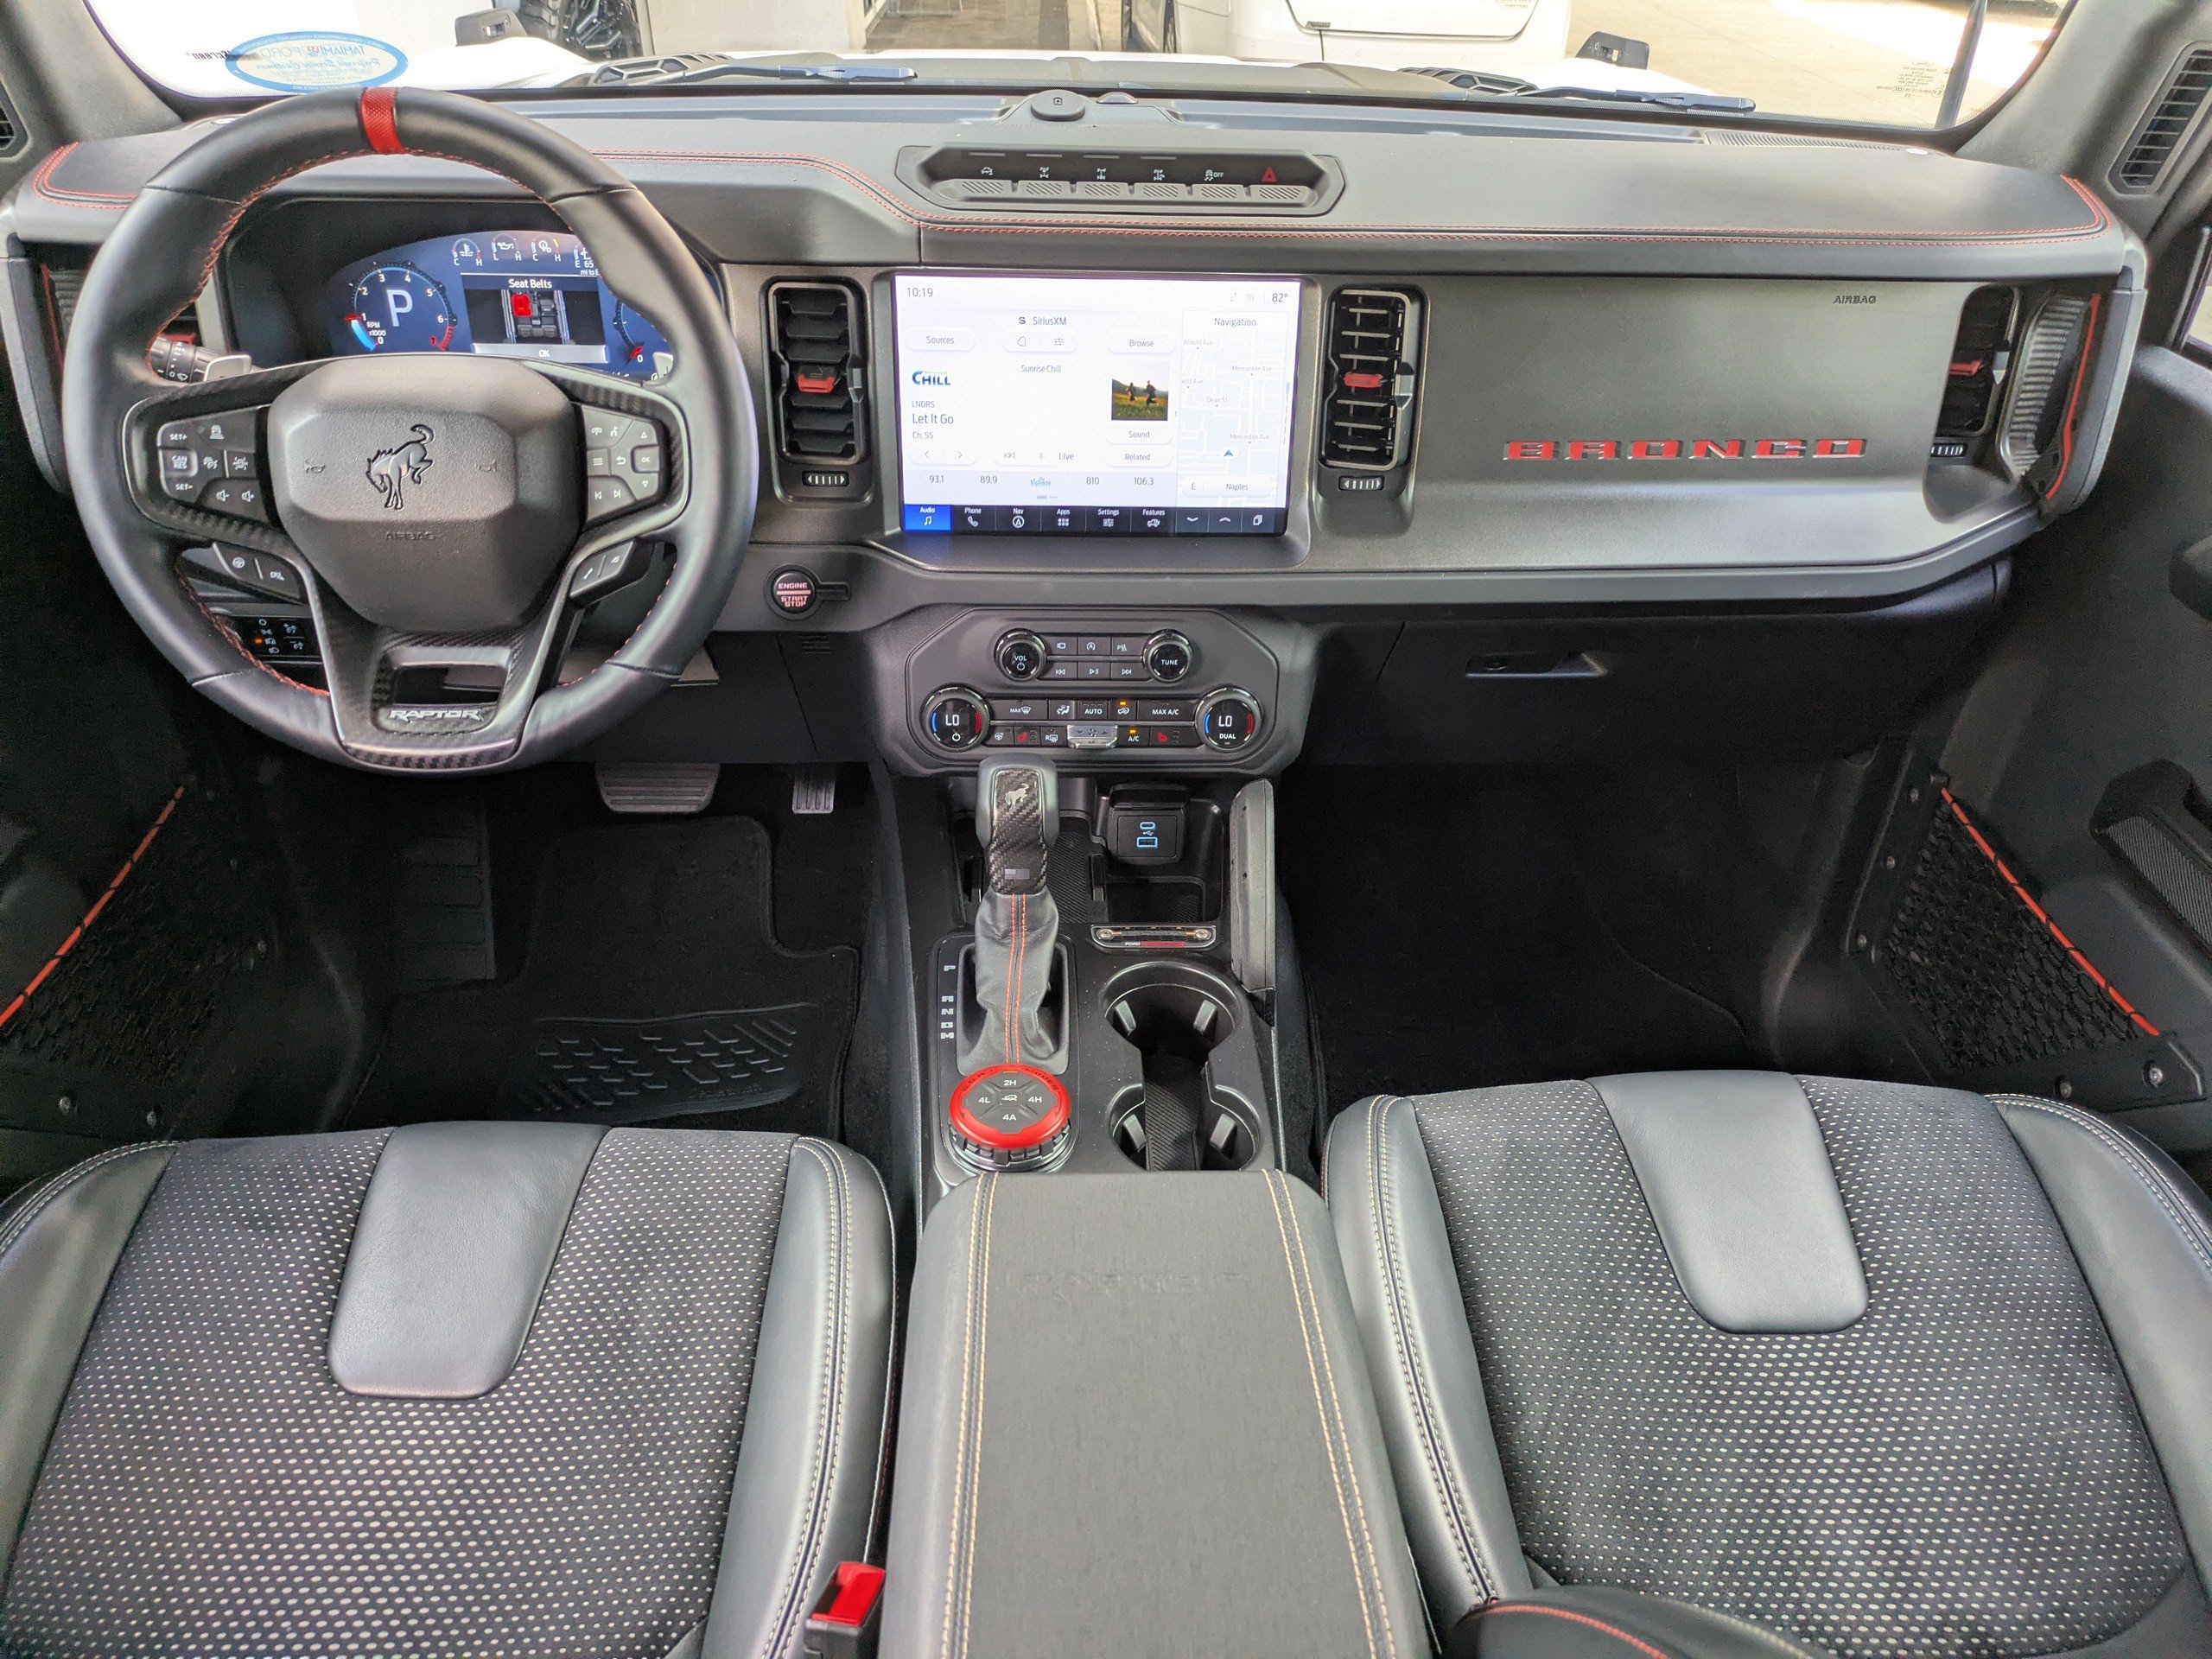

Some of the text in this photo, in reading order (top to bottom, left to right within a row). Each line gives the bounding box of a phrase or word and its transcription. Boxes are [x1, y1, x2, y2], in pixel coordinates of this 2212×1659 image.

[378, 274, 385, 283] 3
[404, 274, 411, 283] 4
[508, 279, 552, 289] Seat Belts
[362, 287, 368, 296] 2
[426, 289, 433, 297] 5
[906, 288, 933, 298] 10:19
[1833, 295, 1877, 305] AIRBAG
[386, 289, 413, 327] P
[1032, 316, 1067, 327] SiriusXM
[1213, 317, 1256, 327] Navigation
[926, 335, 954, 345] Sources
[1128, 339, 1154, 347] Browse
[538, 349, 550, 358] OK
[637, 354, 644, 363] 0
[1020, 365, 1062, 373] Sunrise Chill
[912, 413, 954, 425] Let It Go
[1128, 430, 1150, 439] Sound
[1503, 437, 1868, 461] BRONCO
[1124, 453, 1151, 461] Related
[929, 475, 944, 484] 93.1
[980, 475, 997, 484] 89.9
[1134, 477, 1154, 486] 106.3
[1225, 483, 1249, 493] Naples
[1097, 508, 1120, 517] Settings
[1142, 508, 1166, 517] Features
[389, 709, 484, 722] RAPTOR
